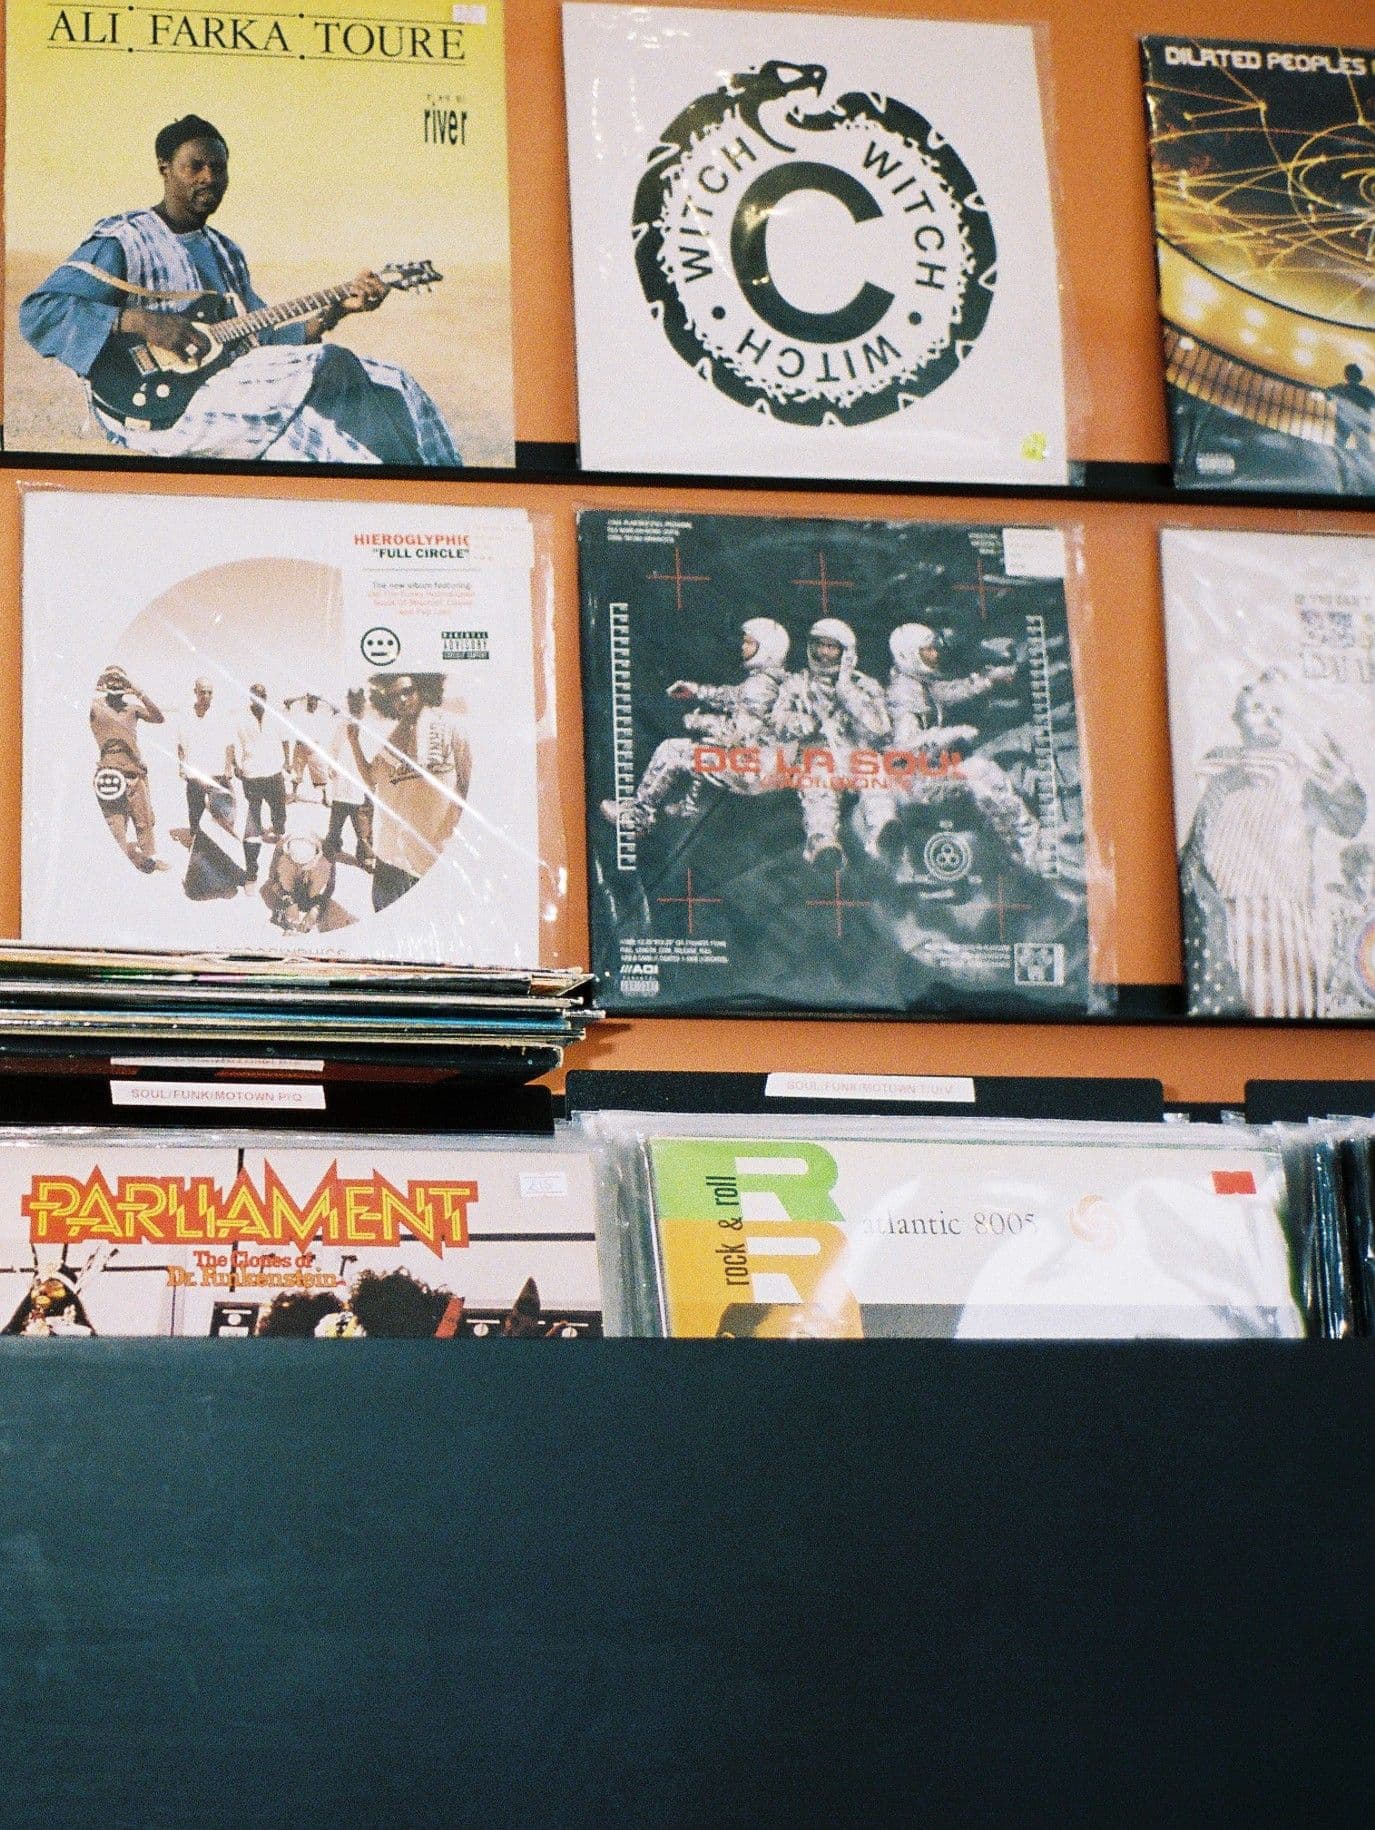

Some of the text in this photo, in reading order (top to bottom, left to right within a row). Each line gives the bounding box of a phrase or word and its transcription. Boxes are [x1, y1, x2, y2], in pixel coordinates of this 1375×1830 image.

[48, 9, 466, 61] ALI FARKA TOURE
[1164, 46, 1262, 70] DILATED
[1266, 52, 1368, 77] PEOPLES
[424, 102, 468, 146] river
[679, 136, 757, 284] WITCH
[862, 140, 947, 291] WITCH
[736, 328, 902, 383] WITCH
[775, 745, 835, 775] LA
[23, 1168, 476, 1250] PARLIAMENT
[705, 1175, 750, 1287] rock & roll
[974, 1211, 1038, 1236] 8005
[193, 1250, 313, 1269] The Clones of
[200, 1264, 338, 1288] Funkenstein
